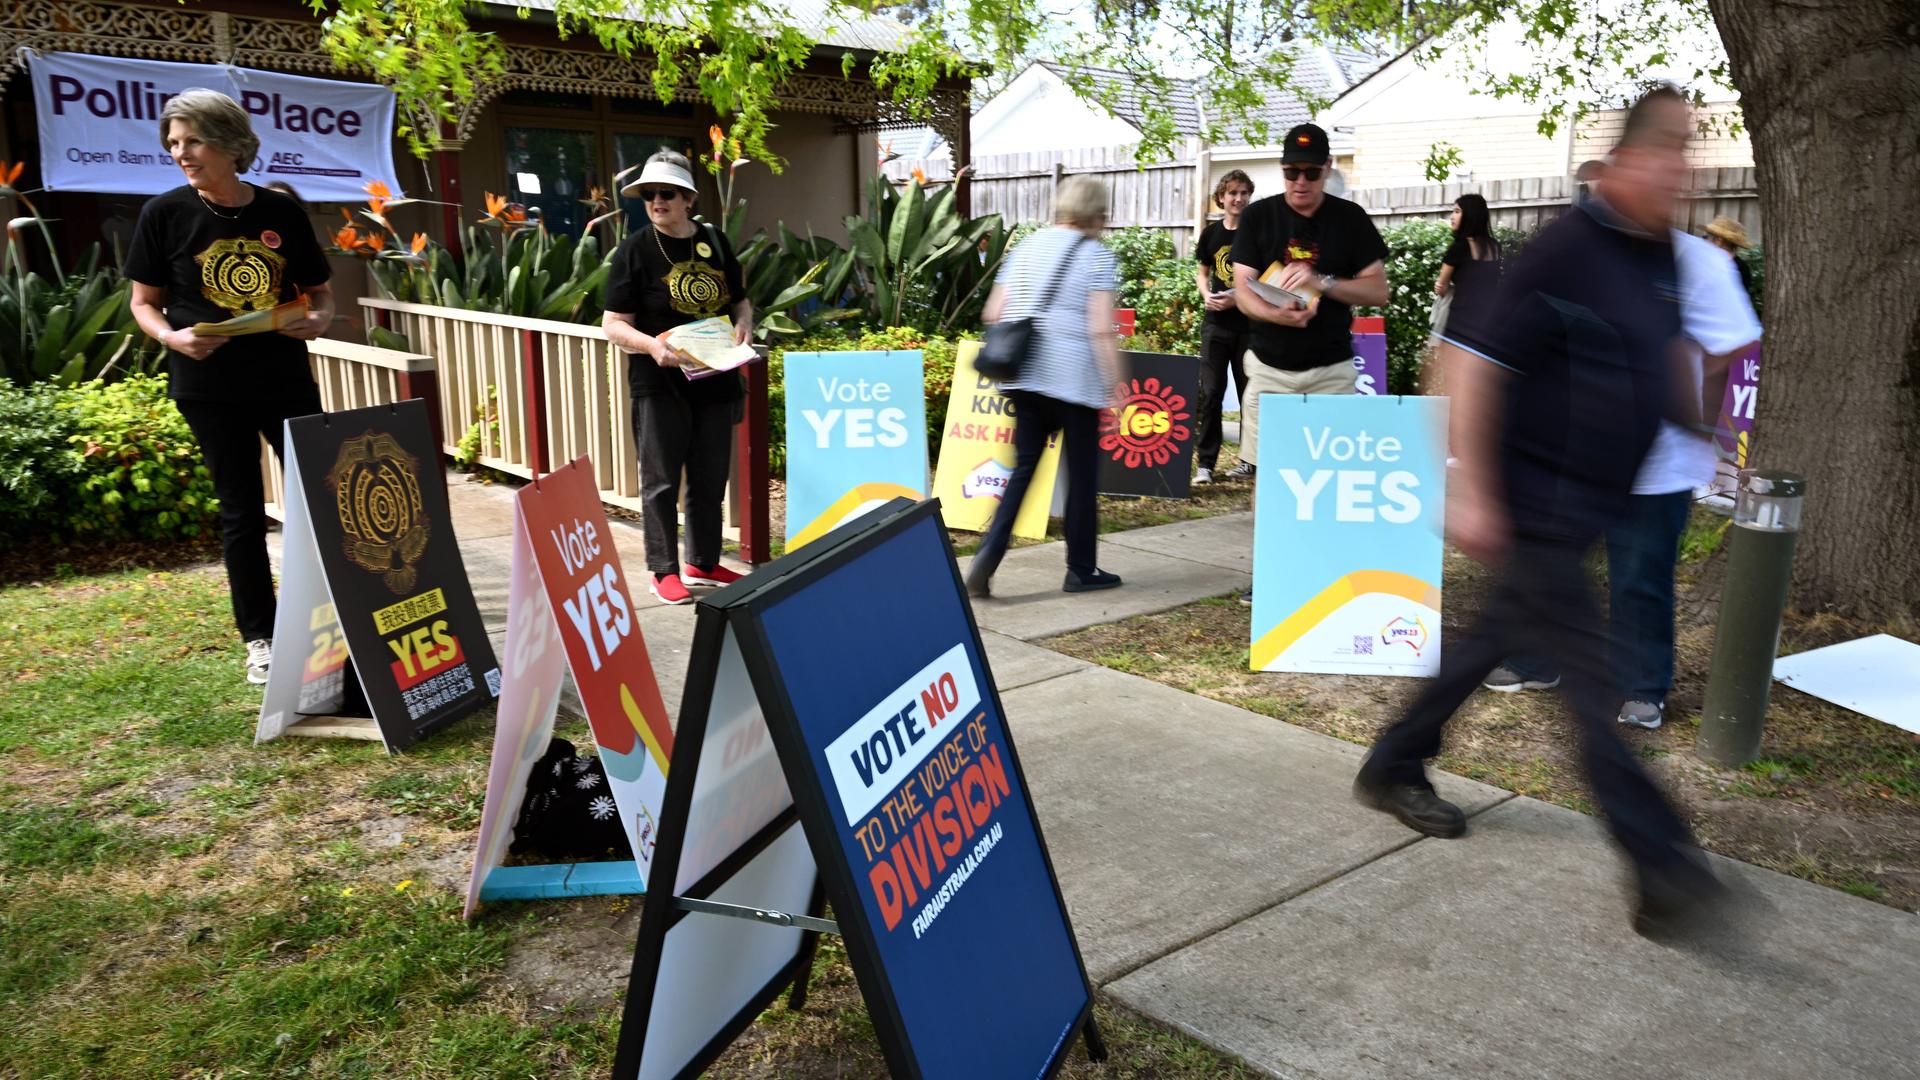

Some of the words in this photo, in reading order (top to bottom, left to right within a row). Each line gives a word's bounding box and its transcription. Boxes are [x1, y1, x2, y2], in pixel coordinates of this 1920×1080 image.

[240, 89, 363, 137] Place
[66, 147, 112, 165] Open
[118, 149, 156, 165] 8am
[270, 152, 304, 165] AEC
[817, 377, 892, 403] Vote
[801, 407, 908, 449] YES
[948, 421, 989, 441] ASK
[1110, 404, 1171, 436] Yes
[1302, 426, 1403, 462] Vote
[1278, 468, 1422, 524] YES
[550, 518, 601, 577] Vote
[562, 562, 631, 673] YES
[387, 619, 457, 679] YES
[850, 699, 926, 789] VOTE
[920, 672, 959, 729] NO
[854, 816, 887, 863] TO
[881, 778, 924, 835] THE
[918, 732, 970, 798] VOICE
[967, 711, 988, 753] OF
[869, 742, 1011, 933] DIVISION
[911, 821, 1003, 940] FAIRAUSTRALIA.COM.AU
